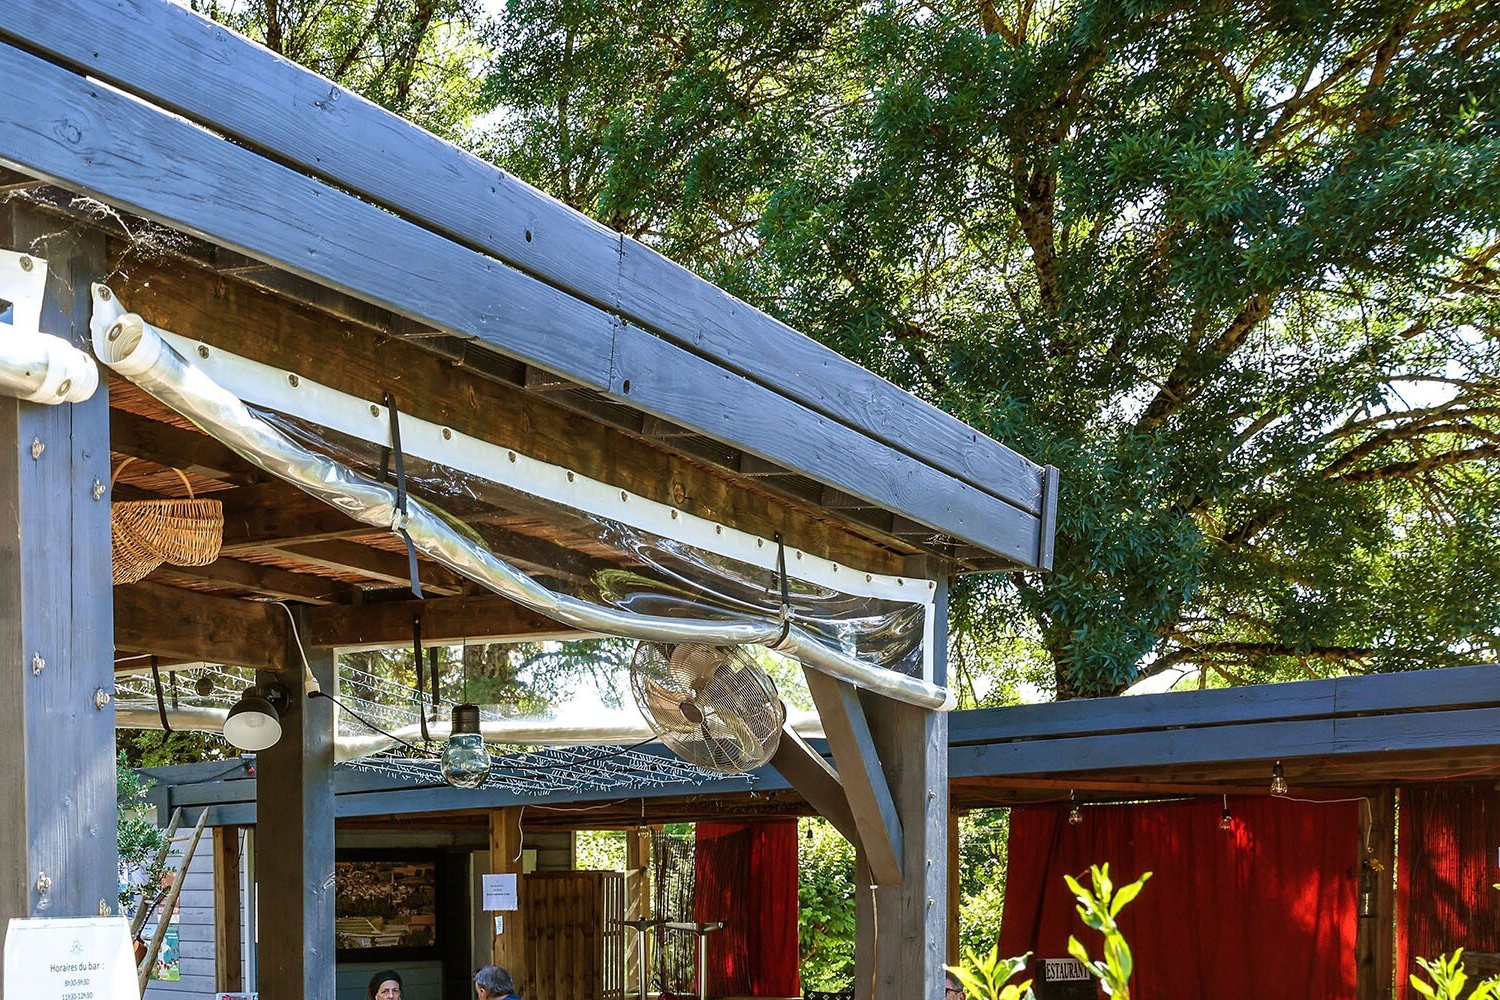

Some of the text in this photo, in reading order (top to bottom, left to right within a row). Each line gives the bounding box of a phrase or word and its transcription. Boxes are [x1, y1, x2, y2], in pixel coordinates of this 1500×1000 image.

[50, 963, 78, 972] Horaires
[79, 961, 87, 971] du
[88, 961, 100, 970] bar
[1046, 962, 1088, 979] ESTAURANT
